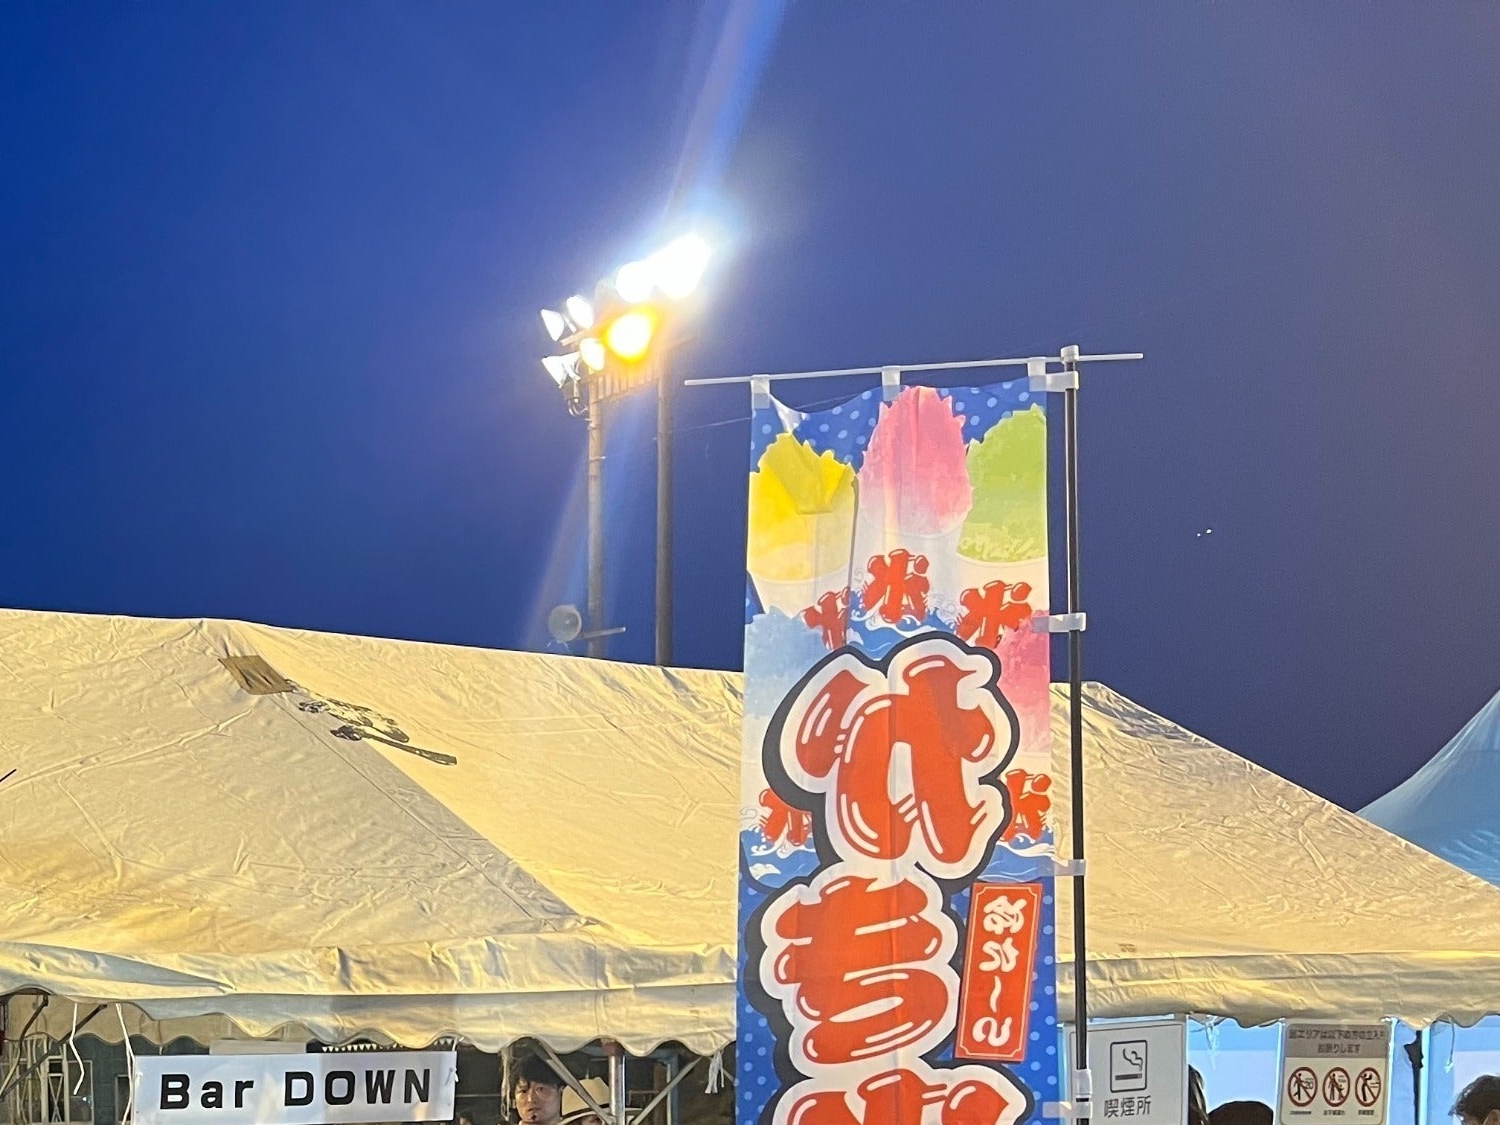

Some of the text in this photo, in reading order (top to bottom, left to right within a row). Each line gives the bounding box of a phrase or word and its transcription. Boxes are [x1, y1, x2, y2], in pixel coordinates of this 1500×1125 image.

[160, 1068, 431, 1110] Bar DOWN
[1103, 1095, 1152, 1118] 喫煙所
